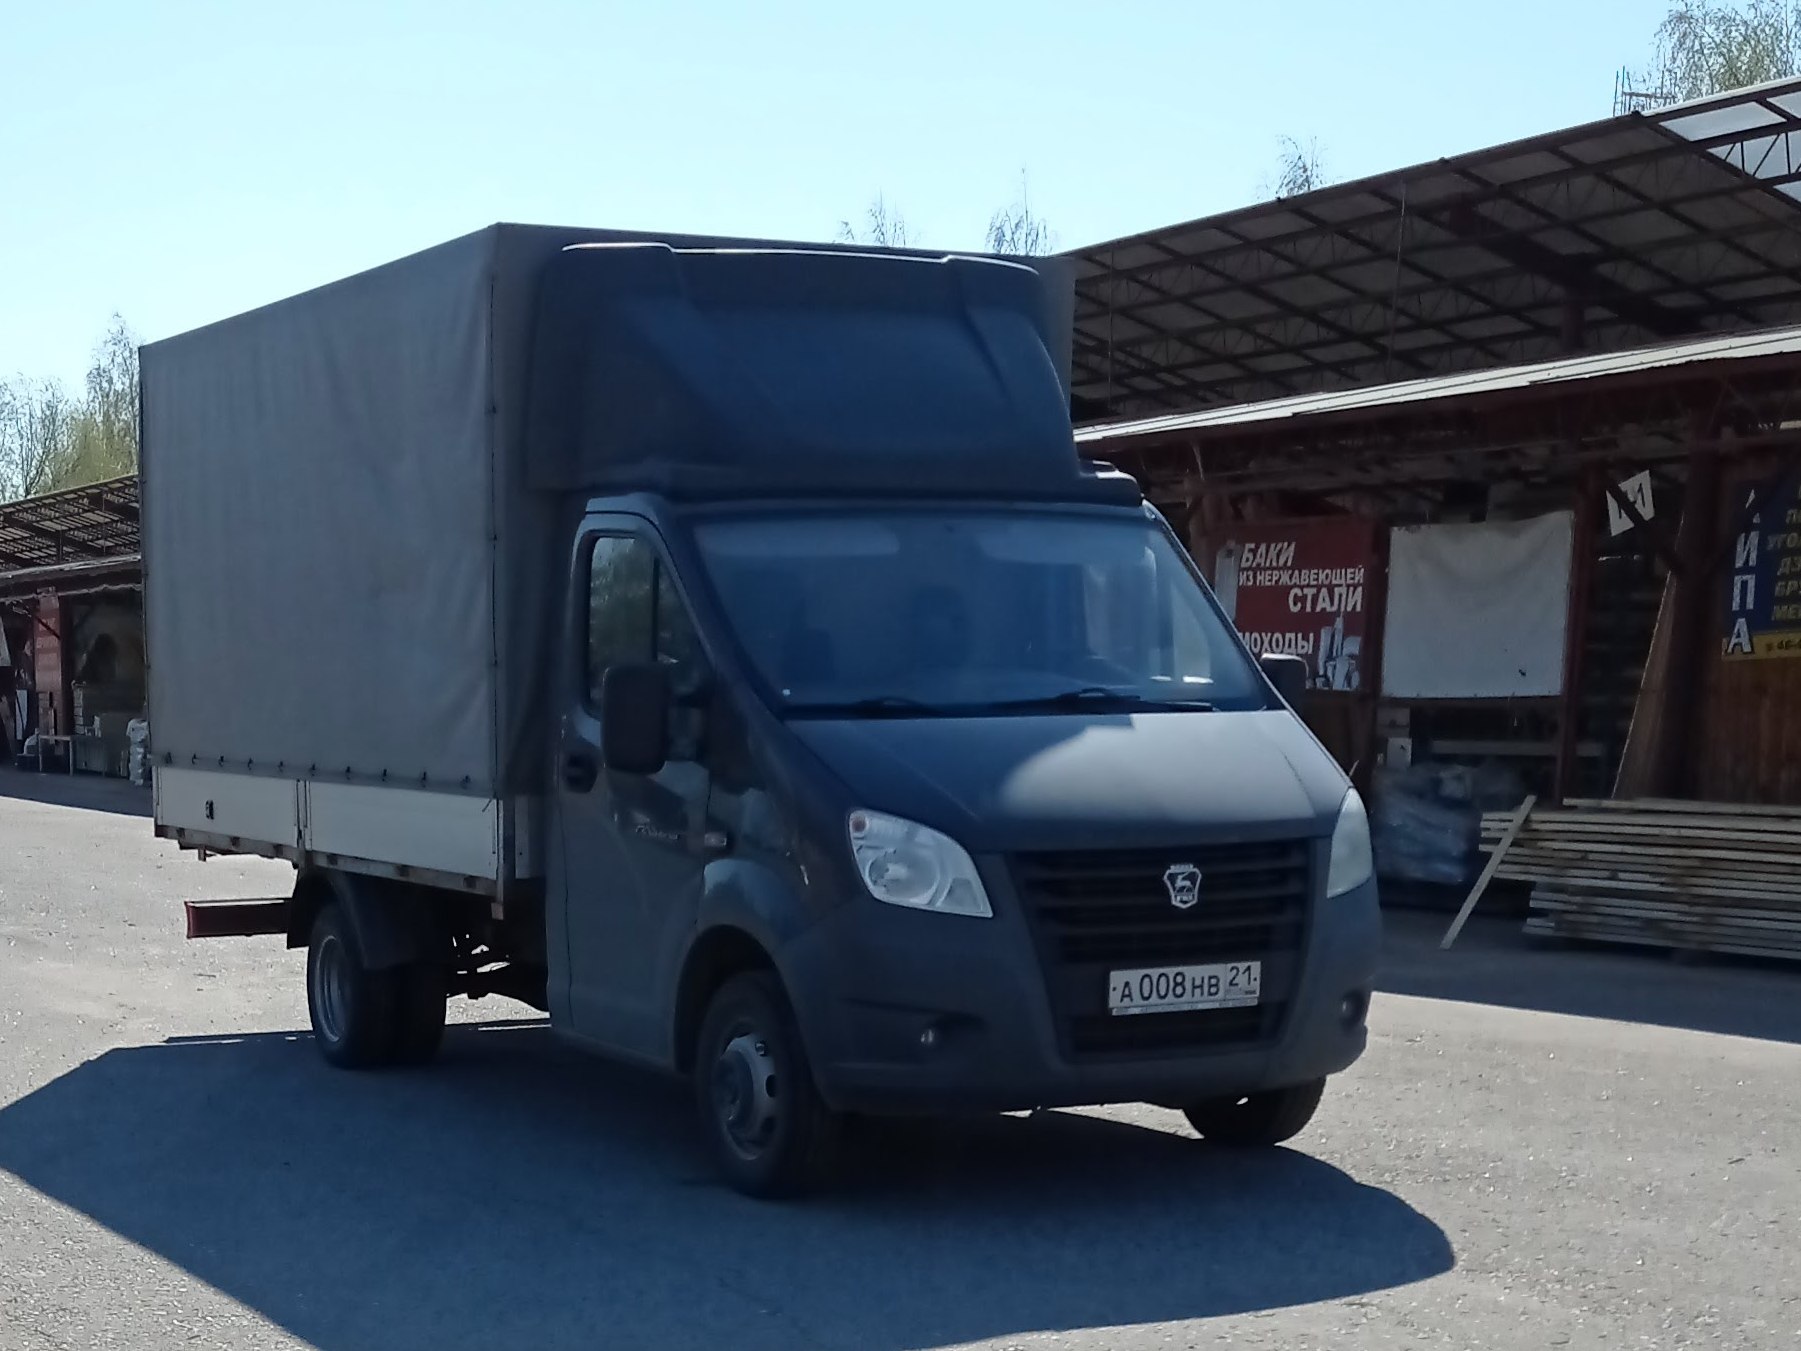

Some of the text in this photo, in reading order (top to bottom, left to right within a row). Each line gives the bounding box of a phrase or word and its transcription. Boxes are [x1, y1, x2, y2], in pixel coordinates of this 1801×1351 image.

[1240, 541, 1296, 568] БАКИ
[1239, 565, 1365, 587] ИЗ НЕРЖАВЕЮЩЕЙ
[1288, 585, 1363, 613] СТАЛИ
[1229, 964, 1252, 987] 21
